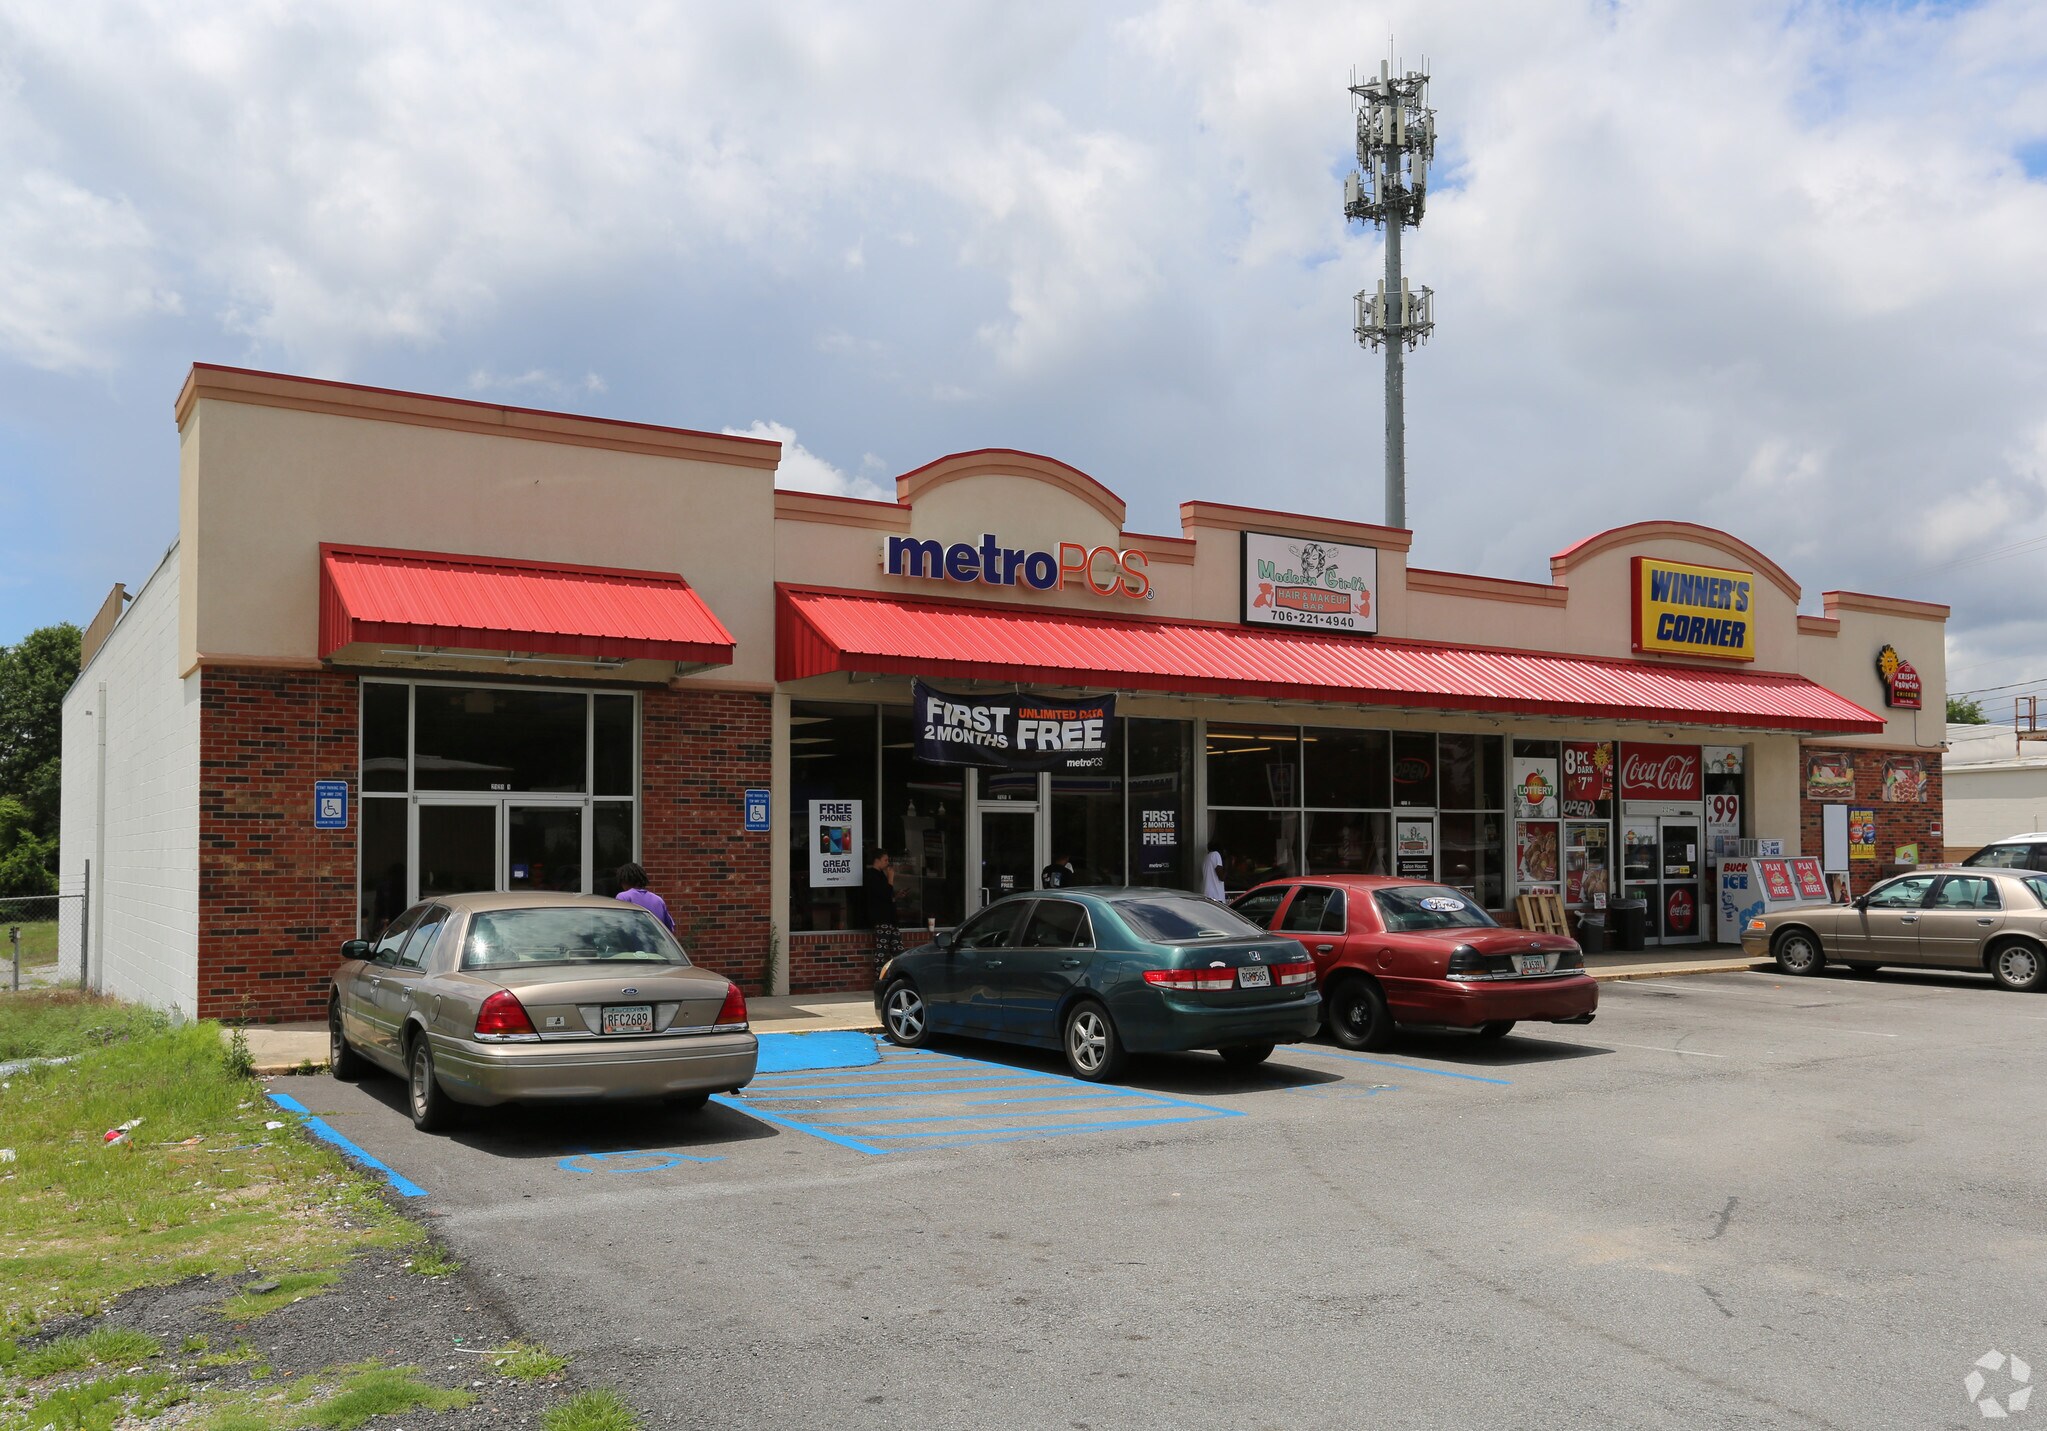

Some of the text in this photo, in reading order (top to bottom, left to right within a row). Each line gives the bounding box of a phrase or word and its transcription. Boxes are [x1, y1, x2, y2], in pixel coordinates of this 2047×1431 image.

[1258, 559, 1366, 592] Modern Girl's
[1278, 588, 1348, 604] HAIR & MAKEUP
[1651, 569, 1750, 612] WINNER'S
[1657, 613, 1746, 648] CORNER
[1898, 673, 1917, 681] KRISPY
[926, 697, 1010, 733] FIRST
[1019, 708, 1103, 720] UNLIMITED DATA
[924, 725, 1009, 749] 2 MONTHS
[1017, 719, 1106, 750] FREE.
[1067, 757, 1103, 767] metroPCS
[1565, 749, 1589, 775] 8 PC
[1577, 766, 1594, 774] DARK
[1622, 753, 1696, 791] Coca-Cola
[1519, 787, 1552, 795] LOTTERY
[819, 803, 852, 814] FREE
[1563, 800, 1591, 816] OPEN
[1142, 811, 1175, 821] FIRST
[1723, 863, 1748, 872] BUCK
[1765, 863, 1781, 871] PLAY
[1797, 862, 1813, 870] PLAY
[1722, 874, 1748, 890] ICE
[1805, 884, 1821, 892] HERE
[1773, 885, 1789, 894] HERE
[608, 1013, 648, 1027] RFC2689
